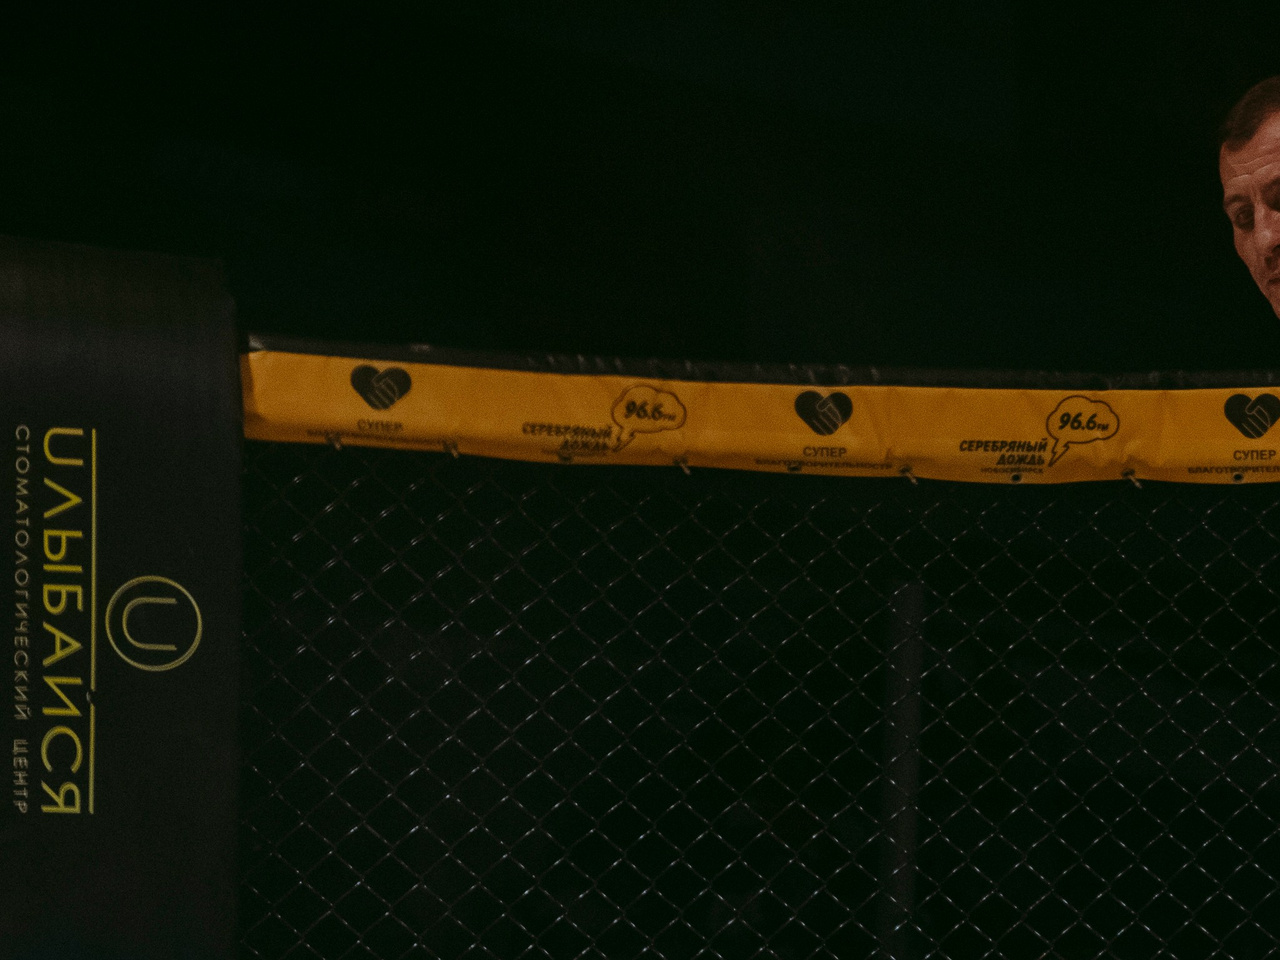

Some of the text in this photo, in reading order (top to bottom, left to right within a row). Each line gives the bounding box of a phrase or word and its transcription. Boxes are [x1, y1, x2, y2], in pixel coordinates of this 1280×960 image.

[802, 446, 847, 458] СУПЕР
[959, 437, 1049, 454] СЕРЕБРЯНЫЙ
[997, 453, 1046, 466] ДОЖДЬ
[1233, 449, 1277, 461] СУПЕР
[12, 424, 31, 815] СТОМАТОЛОГИЧЕСКИЙ ЦЕНТР
